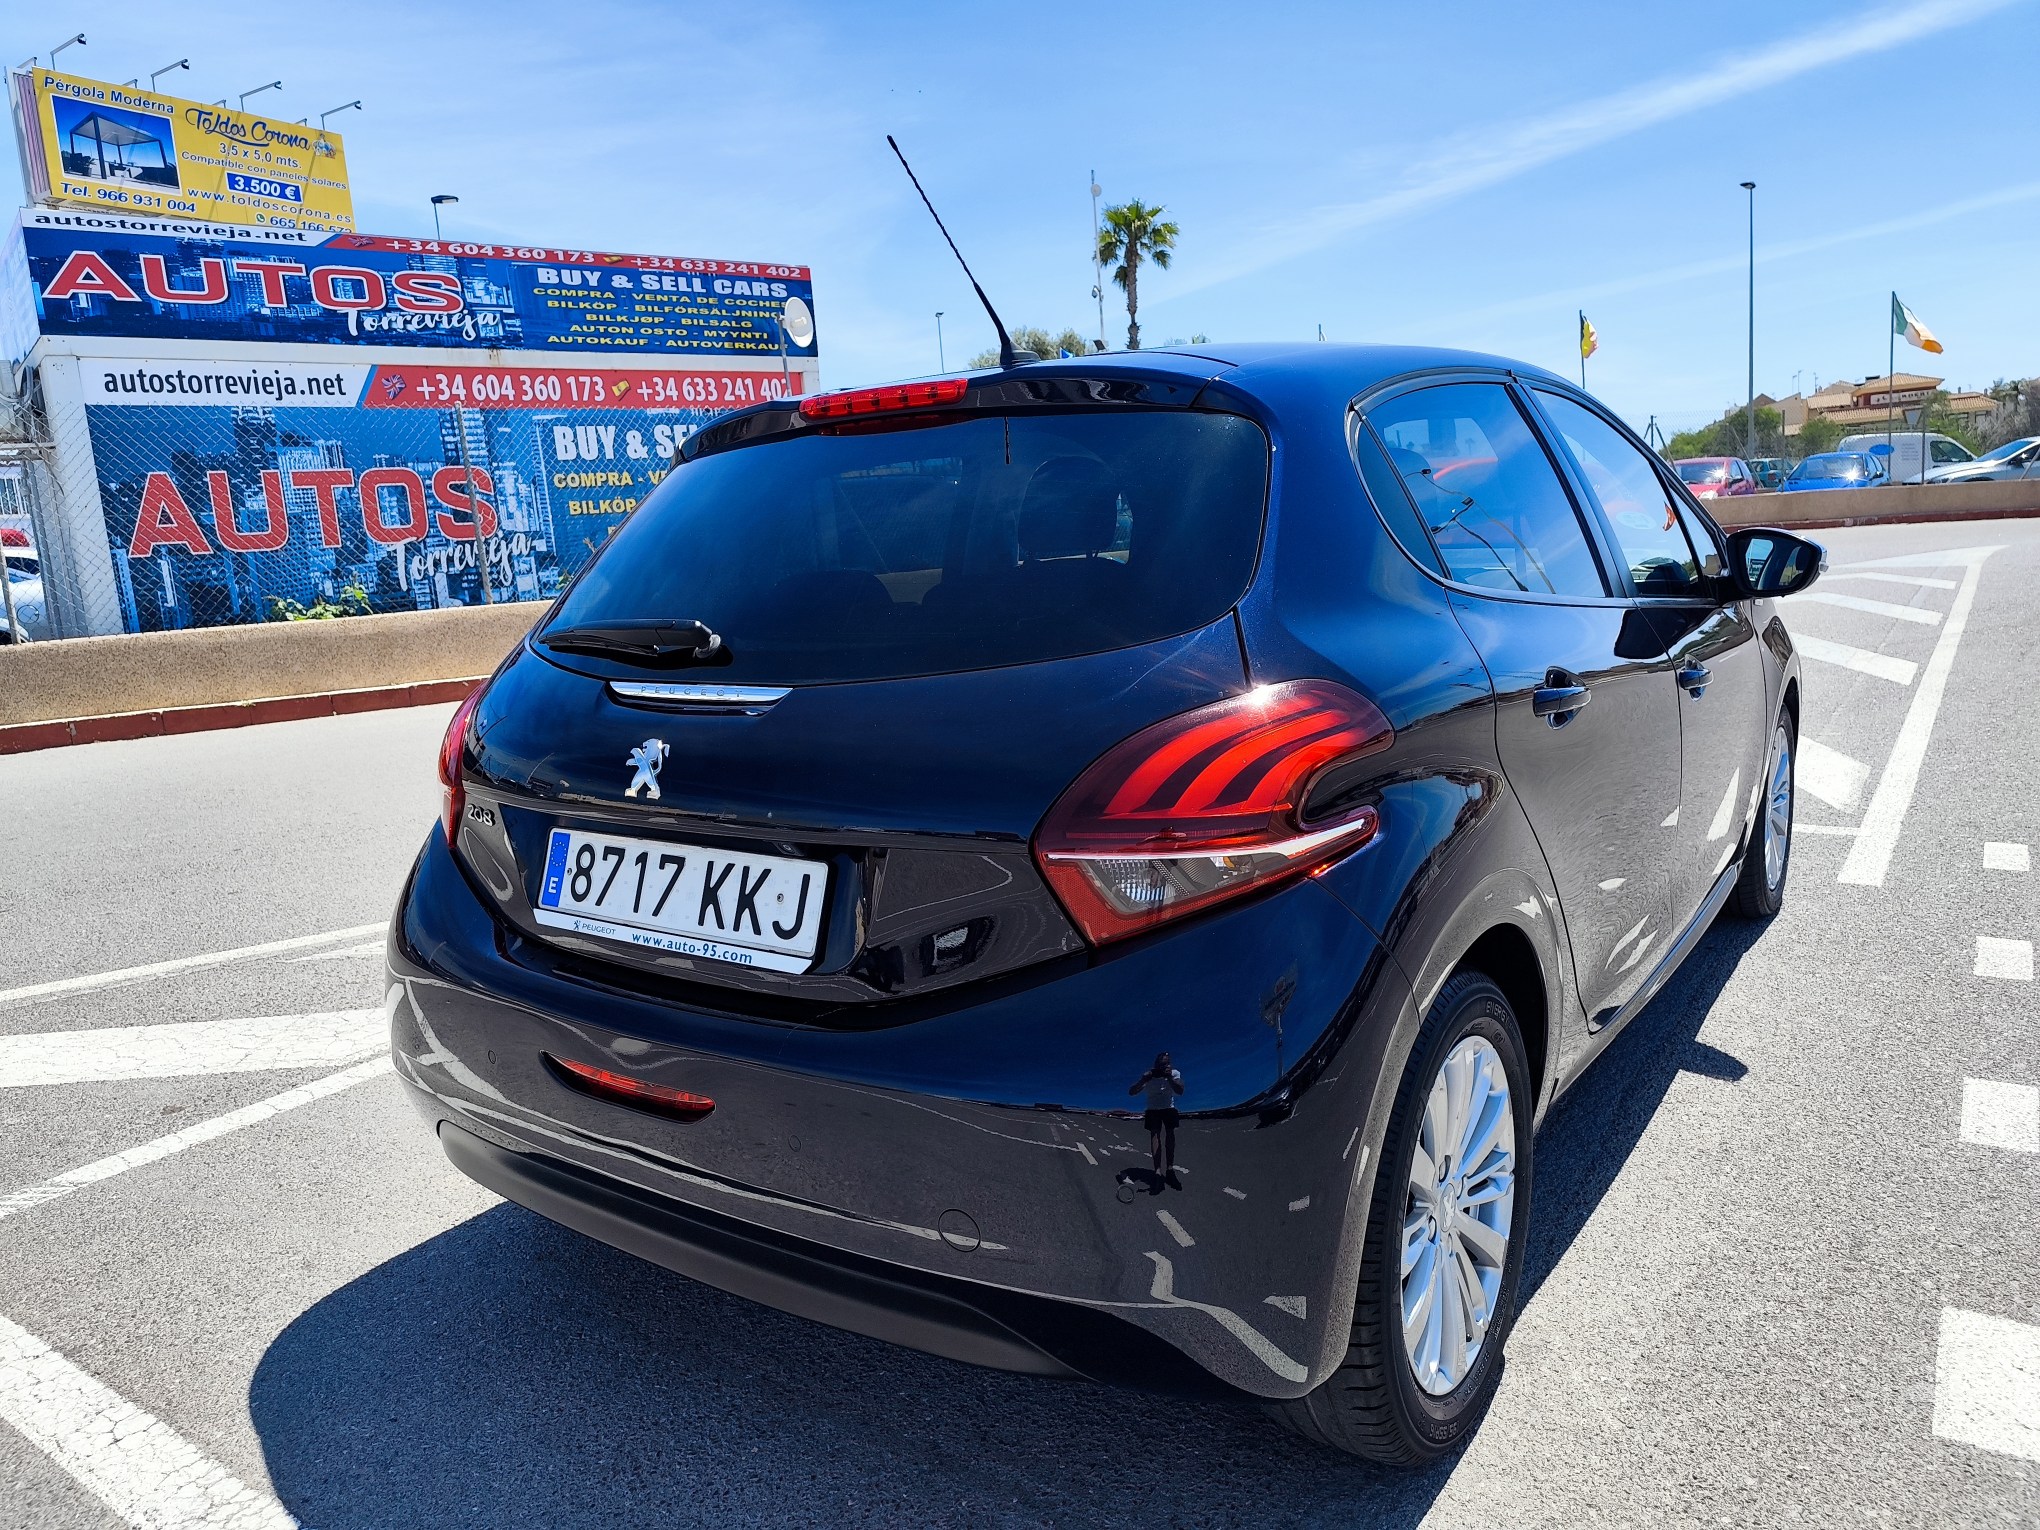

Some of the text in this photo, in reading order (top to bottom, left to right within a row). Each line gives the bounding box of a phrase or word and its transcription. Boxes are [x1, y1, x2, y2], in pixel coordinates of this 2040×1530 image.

[44, 76, 174, 114] Pérgola Moderna
[185, 108, 311, 151] Toldos Corona
[219, 142, 302, 169] 3,5 x 5,0 mts.
[181, 150, 347, 190] Compatible con paneles solares
[60, 181, 196, 213] Tel. 966 931 004
[234, 176, 297, 200] 3.500 €
[187, 187, 352, 223] www.toldoscorona.es
[35, 214, 308, 242] autostorrevieja.net
[270, 216, 296, 229] 665
[386, 240, 595, 263] +34 604 360 173
[631, 257, 802, 278] +34 633 241 402
[42, 249, 464, 314] AUTOS
[537, 267, 788, 298] BUY & SELL CARS
[533, 287, 616, 299] COMPRA
[631, 293, 691, 303] VENTA
[697, 297, 719, 305] DE
[547, 300, 618, 311] BILKÖP
[337, 307, 500, 341] Torrevieja
[569, 324, 634, 334] AUTON
[639, 328, 688, 336] OSTO
[704, 329, 768, 340] MYYNTI
[585, 313, 665, 324] BILKJØP
[681, 318, 753, 328] BILSALG
[547, 335, 649, 346] AUTOKAUF
[103, 368, 347, 401] autostorrevieja.net
[416, 373, 606, 401] +34 604 360 173
[637, 376, 679, 402] +34
[682, 377, 718, 402] 633
[721, 377, 756, 401] 241
[553, 425, 616, 461] BUY
[626, 430, 649, 460] &
[553, 471, 633, 488] COMPRA
[128, 465, 498, 559] AUTOS
[568, 496, 637, 516] BILKÖP
[387, 533, 532, 592] Torreveja
[641, 685, 743, 698] PEUGEOT
[467, 803, 496, 827] 208
[548, 843, 811, 940] E 8717 KKJ
[582, 922, 617, 936] PEUGEOT
[632, 931, 753, 965] www.auto-95.com
